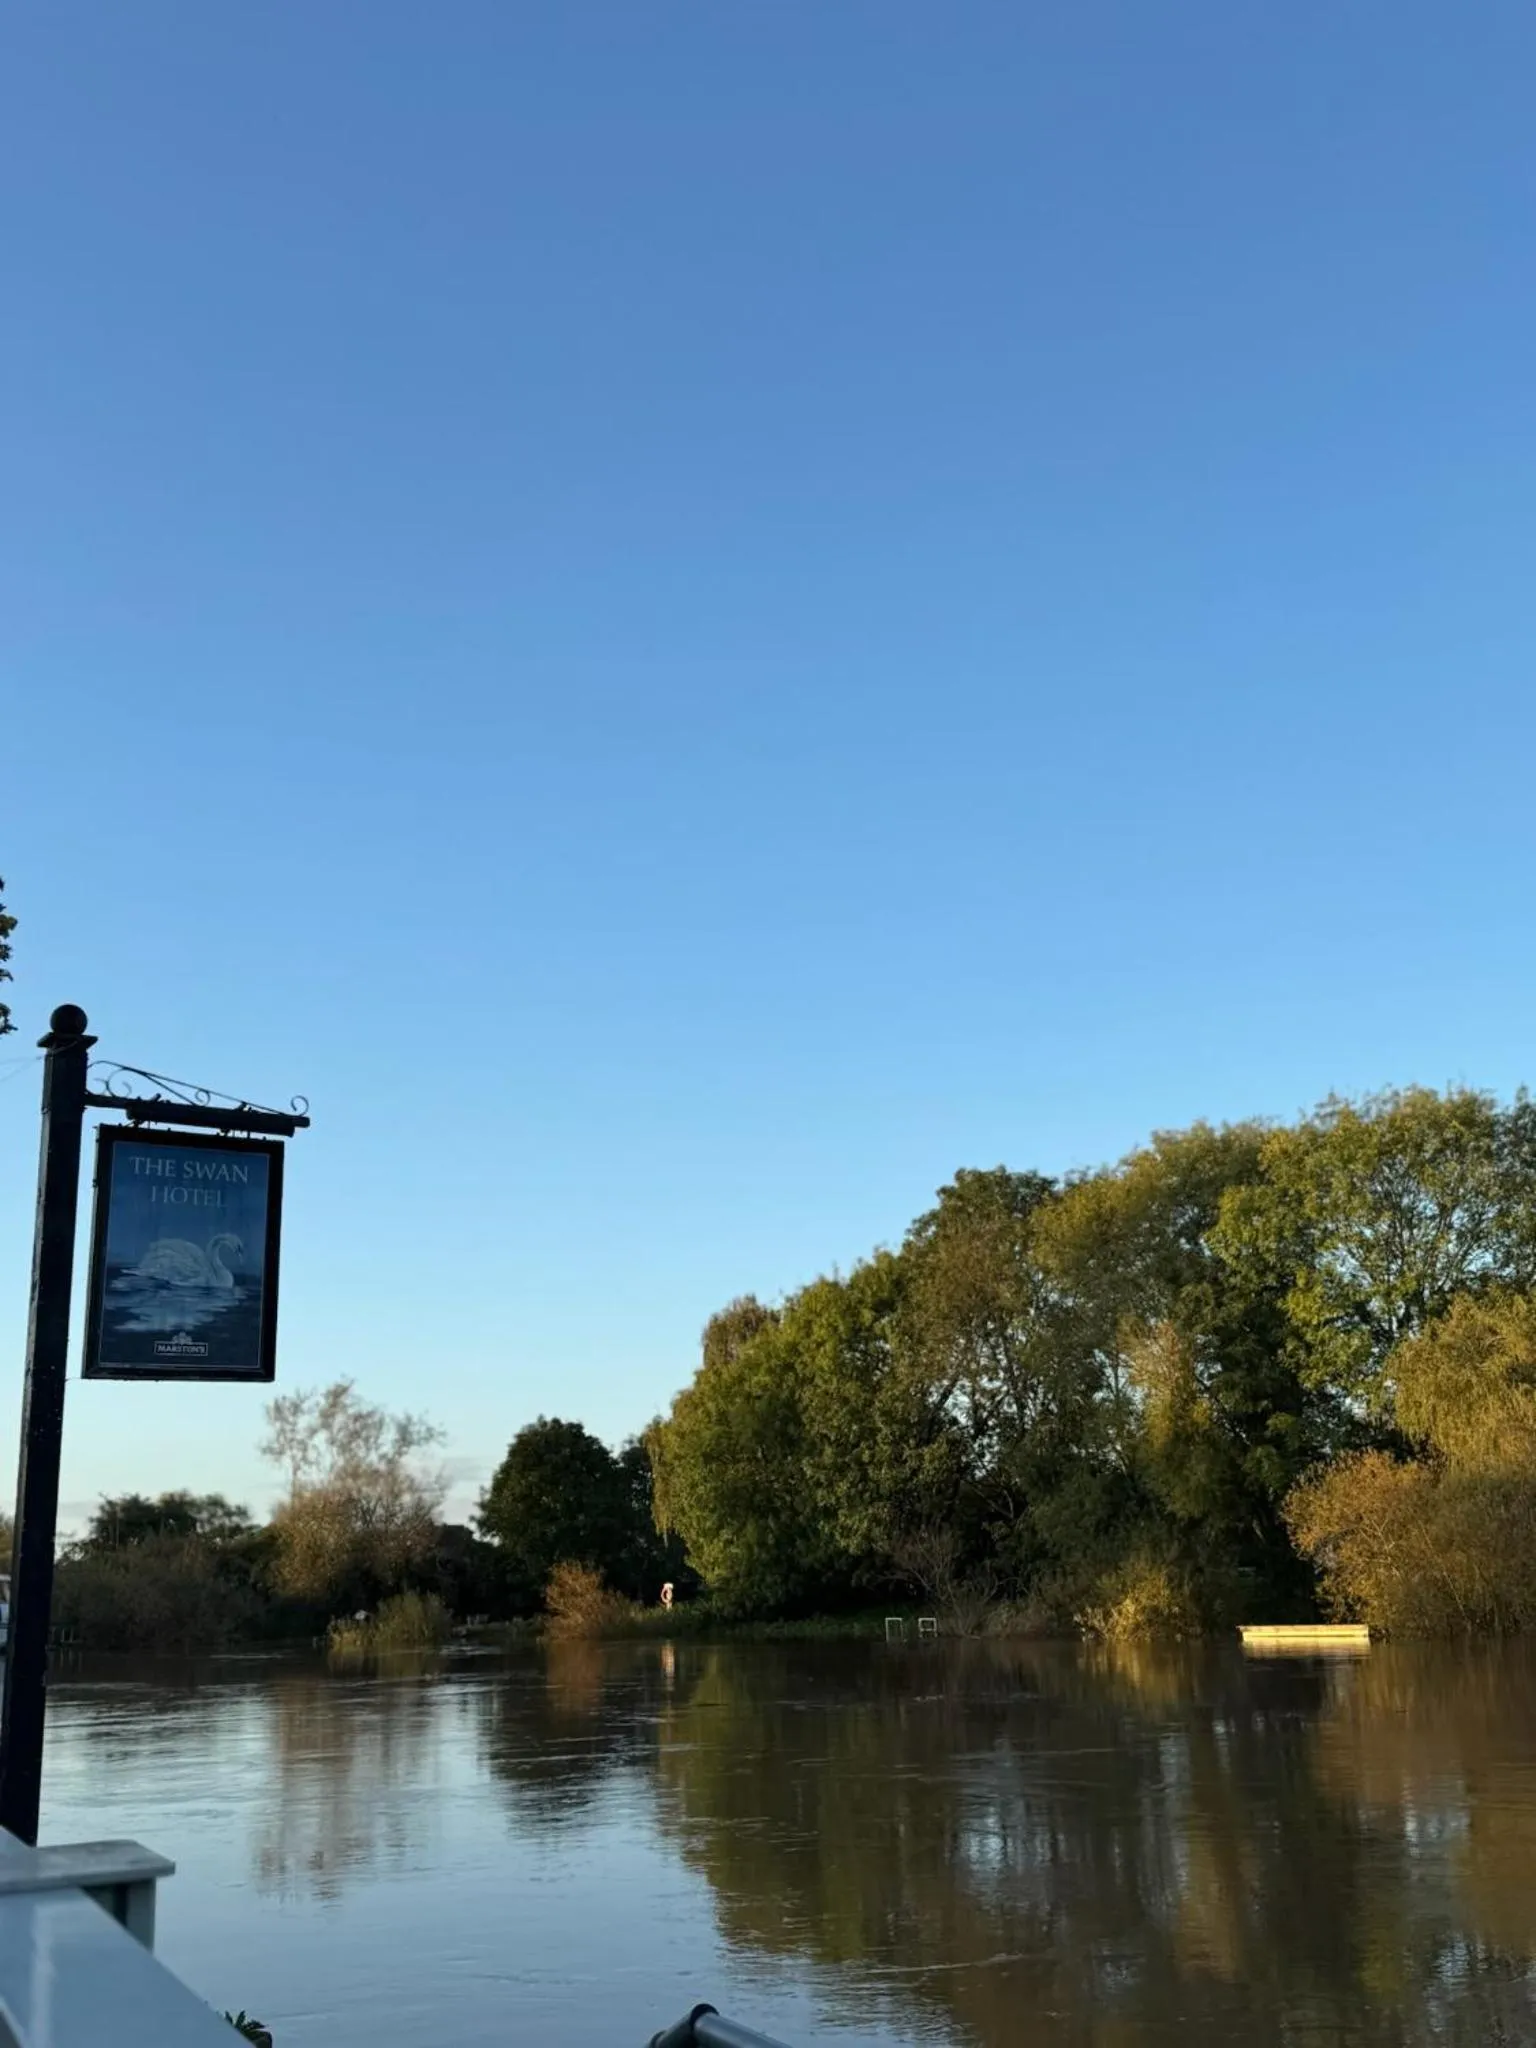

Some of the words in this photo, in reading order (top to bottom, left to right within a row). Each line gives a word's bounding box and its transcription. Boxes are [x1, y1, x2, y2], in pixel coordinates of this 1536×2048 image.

[129, 1156, 176, 1178] THE
[183, 1161, 249, 1184] SWAN
[150, 1185, 228, 1208] HOTEL
